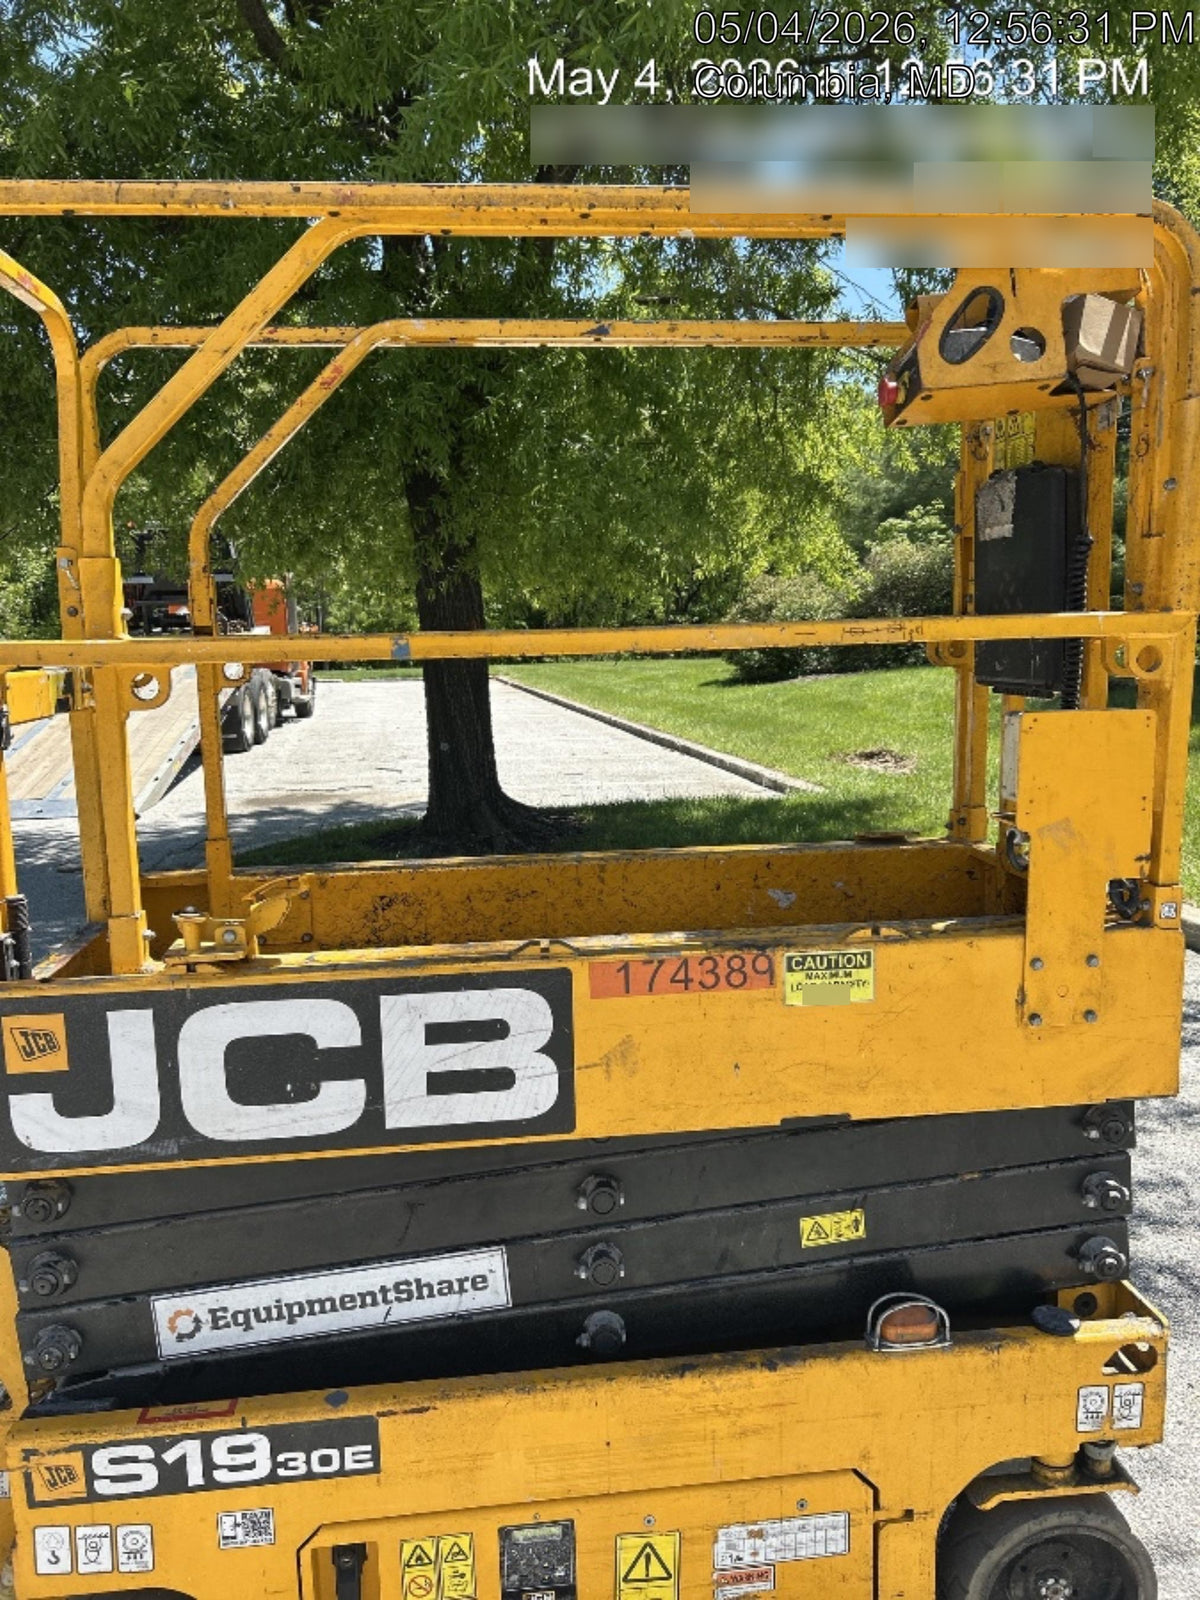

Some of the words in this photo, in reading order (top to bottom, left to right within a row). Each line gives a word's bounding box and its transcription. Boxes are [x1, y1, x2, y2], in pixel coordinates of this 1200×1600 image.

[616, 953, 775, 994] 174389
[792, 954, 867, 970] CAUTION
[19, 1030, 57, 1058] JCB
[8, 987, 559, 1153] JCB
[207, 1273, 490, 1333] EquipmentShare
[43, 1465, 78, 1489] JCB
